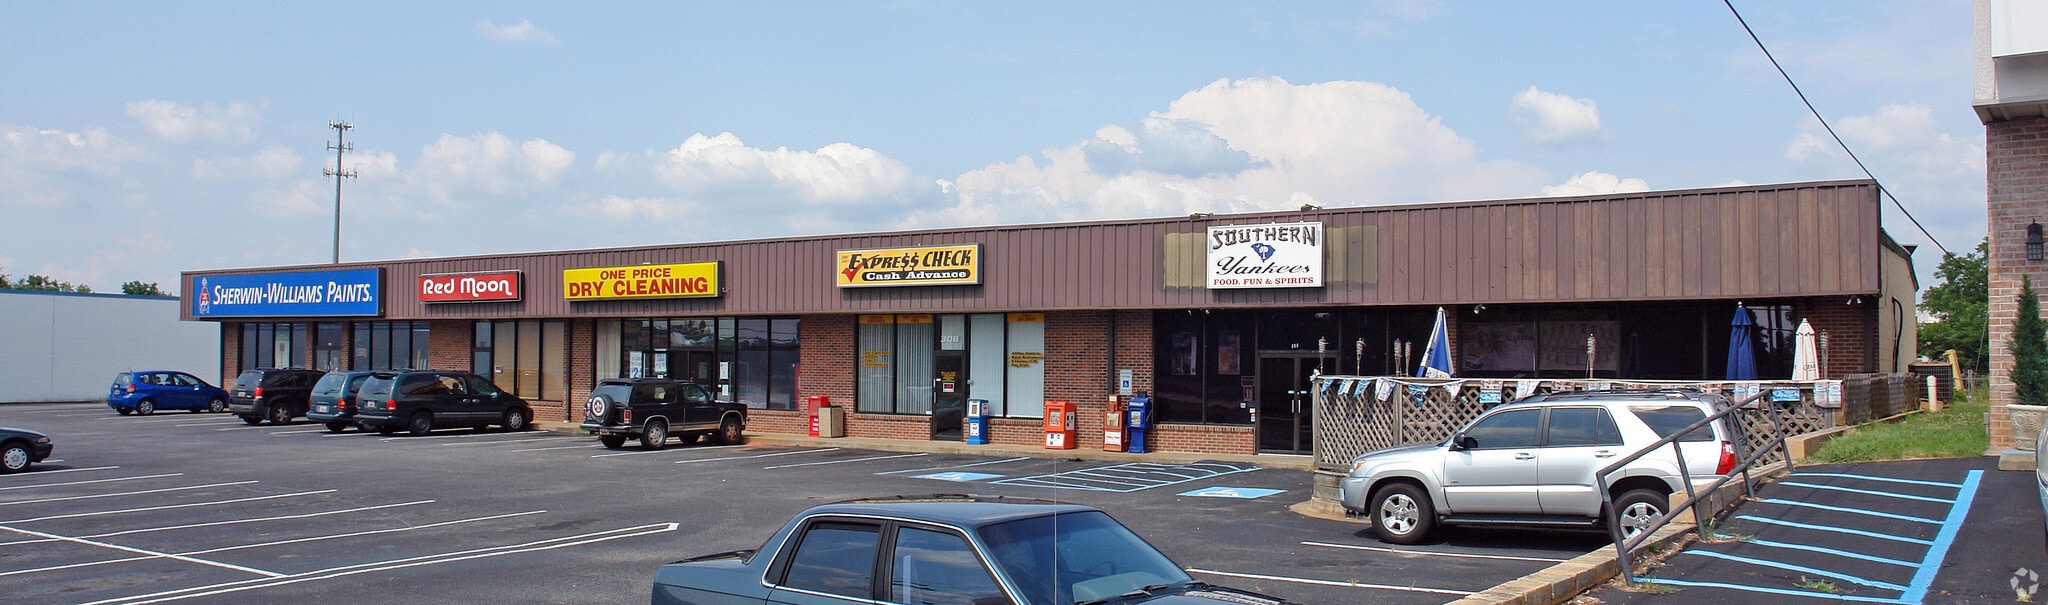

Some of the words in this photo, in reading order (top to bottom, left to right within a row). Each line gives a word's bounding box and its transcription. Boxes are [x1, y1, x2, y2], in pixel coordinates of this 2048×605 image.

[1212, 226, 1316, 250] SOUTHERN
[922, 249, 972, 268] CHECK
[1215, 255, 1311, 276] Yankees
[600, 270, 626, 280] ONE
[632, 267, 671, 279] PRICE
[865, 272, 901, 281] Cash
[905, 270, 967, 280] Advance
[1274, 277, 1314, 285] SPIRITS
[213, 282, 323, 305] SHERWIN-WILLIAMS
[423, 278, 455, 295] Red
[460, 277, 513, 298] Moon
[569, 281, 604, 297] DRY
[613, 276, 708, 296] CLEANING
[940, 335, 959, 343] 308
